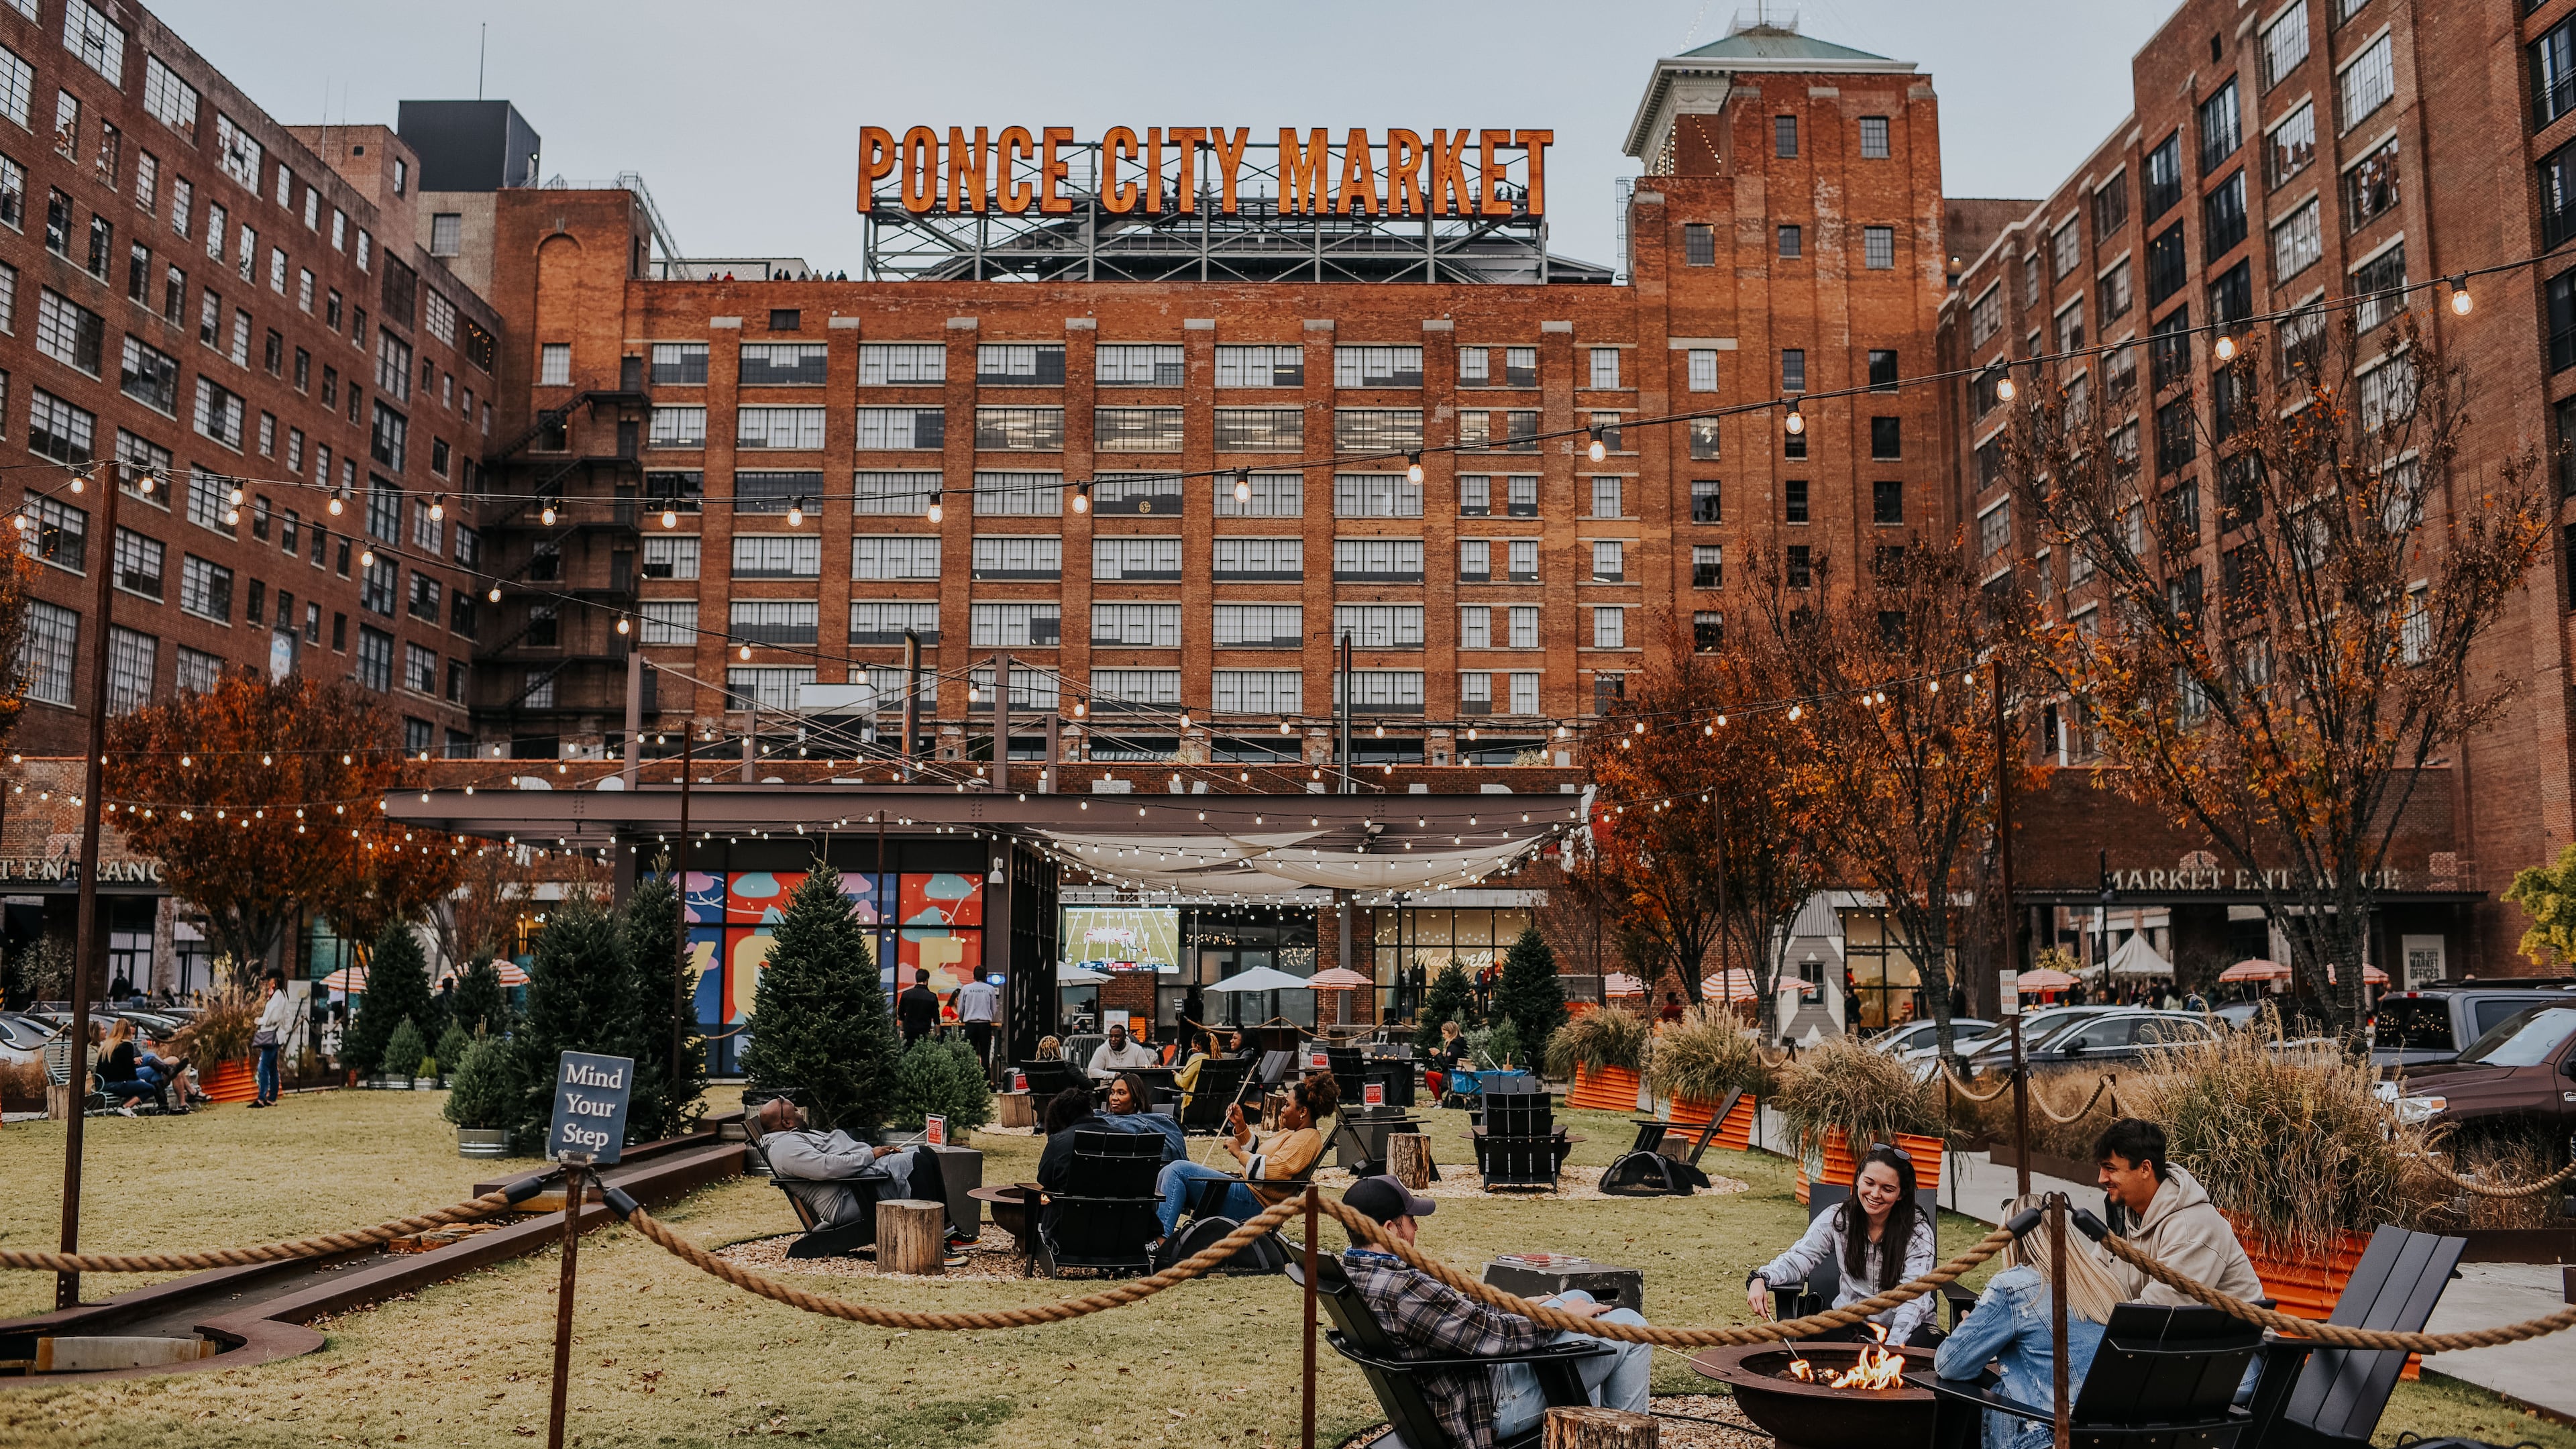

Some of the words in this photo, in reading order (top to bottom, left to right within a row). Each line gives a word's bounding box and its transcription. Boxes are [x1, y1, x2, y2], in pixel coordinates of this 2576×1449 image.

[857, 125, 1074, 213] PONCE
[1102, 125, 1250, 214] CITY
[1279, 127, 1554, 216] MARKET
[1407, 949, 1497, 971] Madwell
[2410, 968, 2440, 979] OFFICES
[565, 1063, 623, 1089] Mind
[566, 1093, 616, 1117] Your
[562, 1123, 609, 1152] Step
